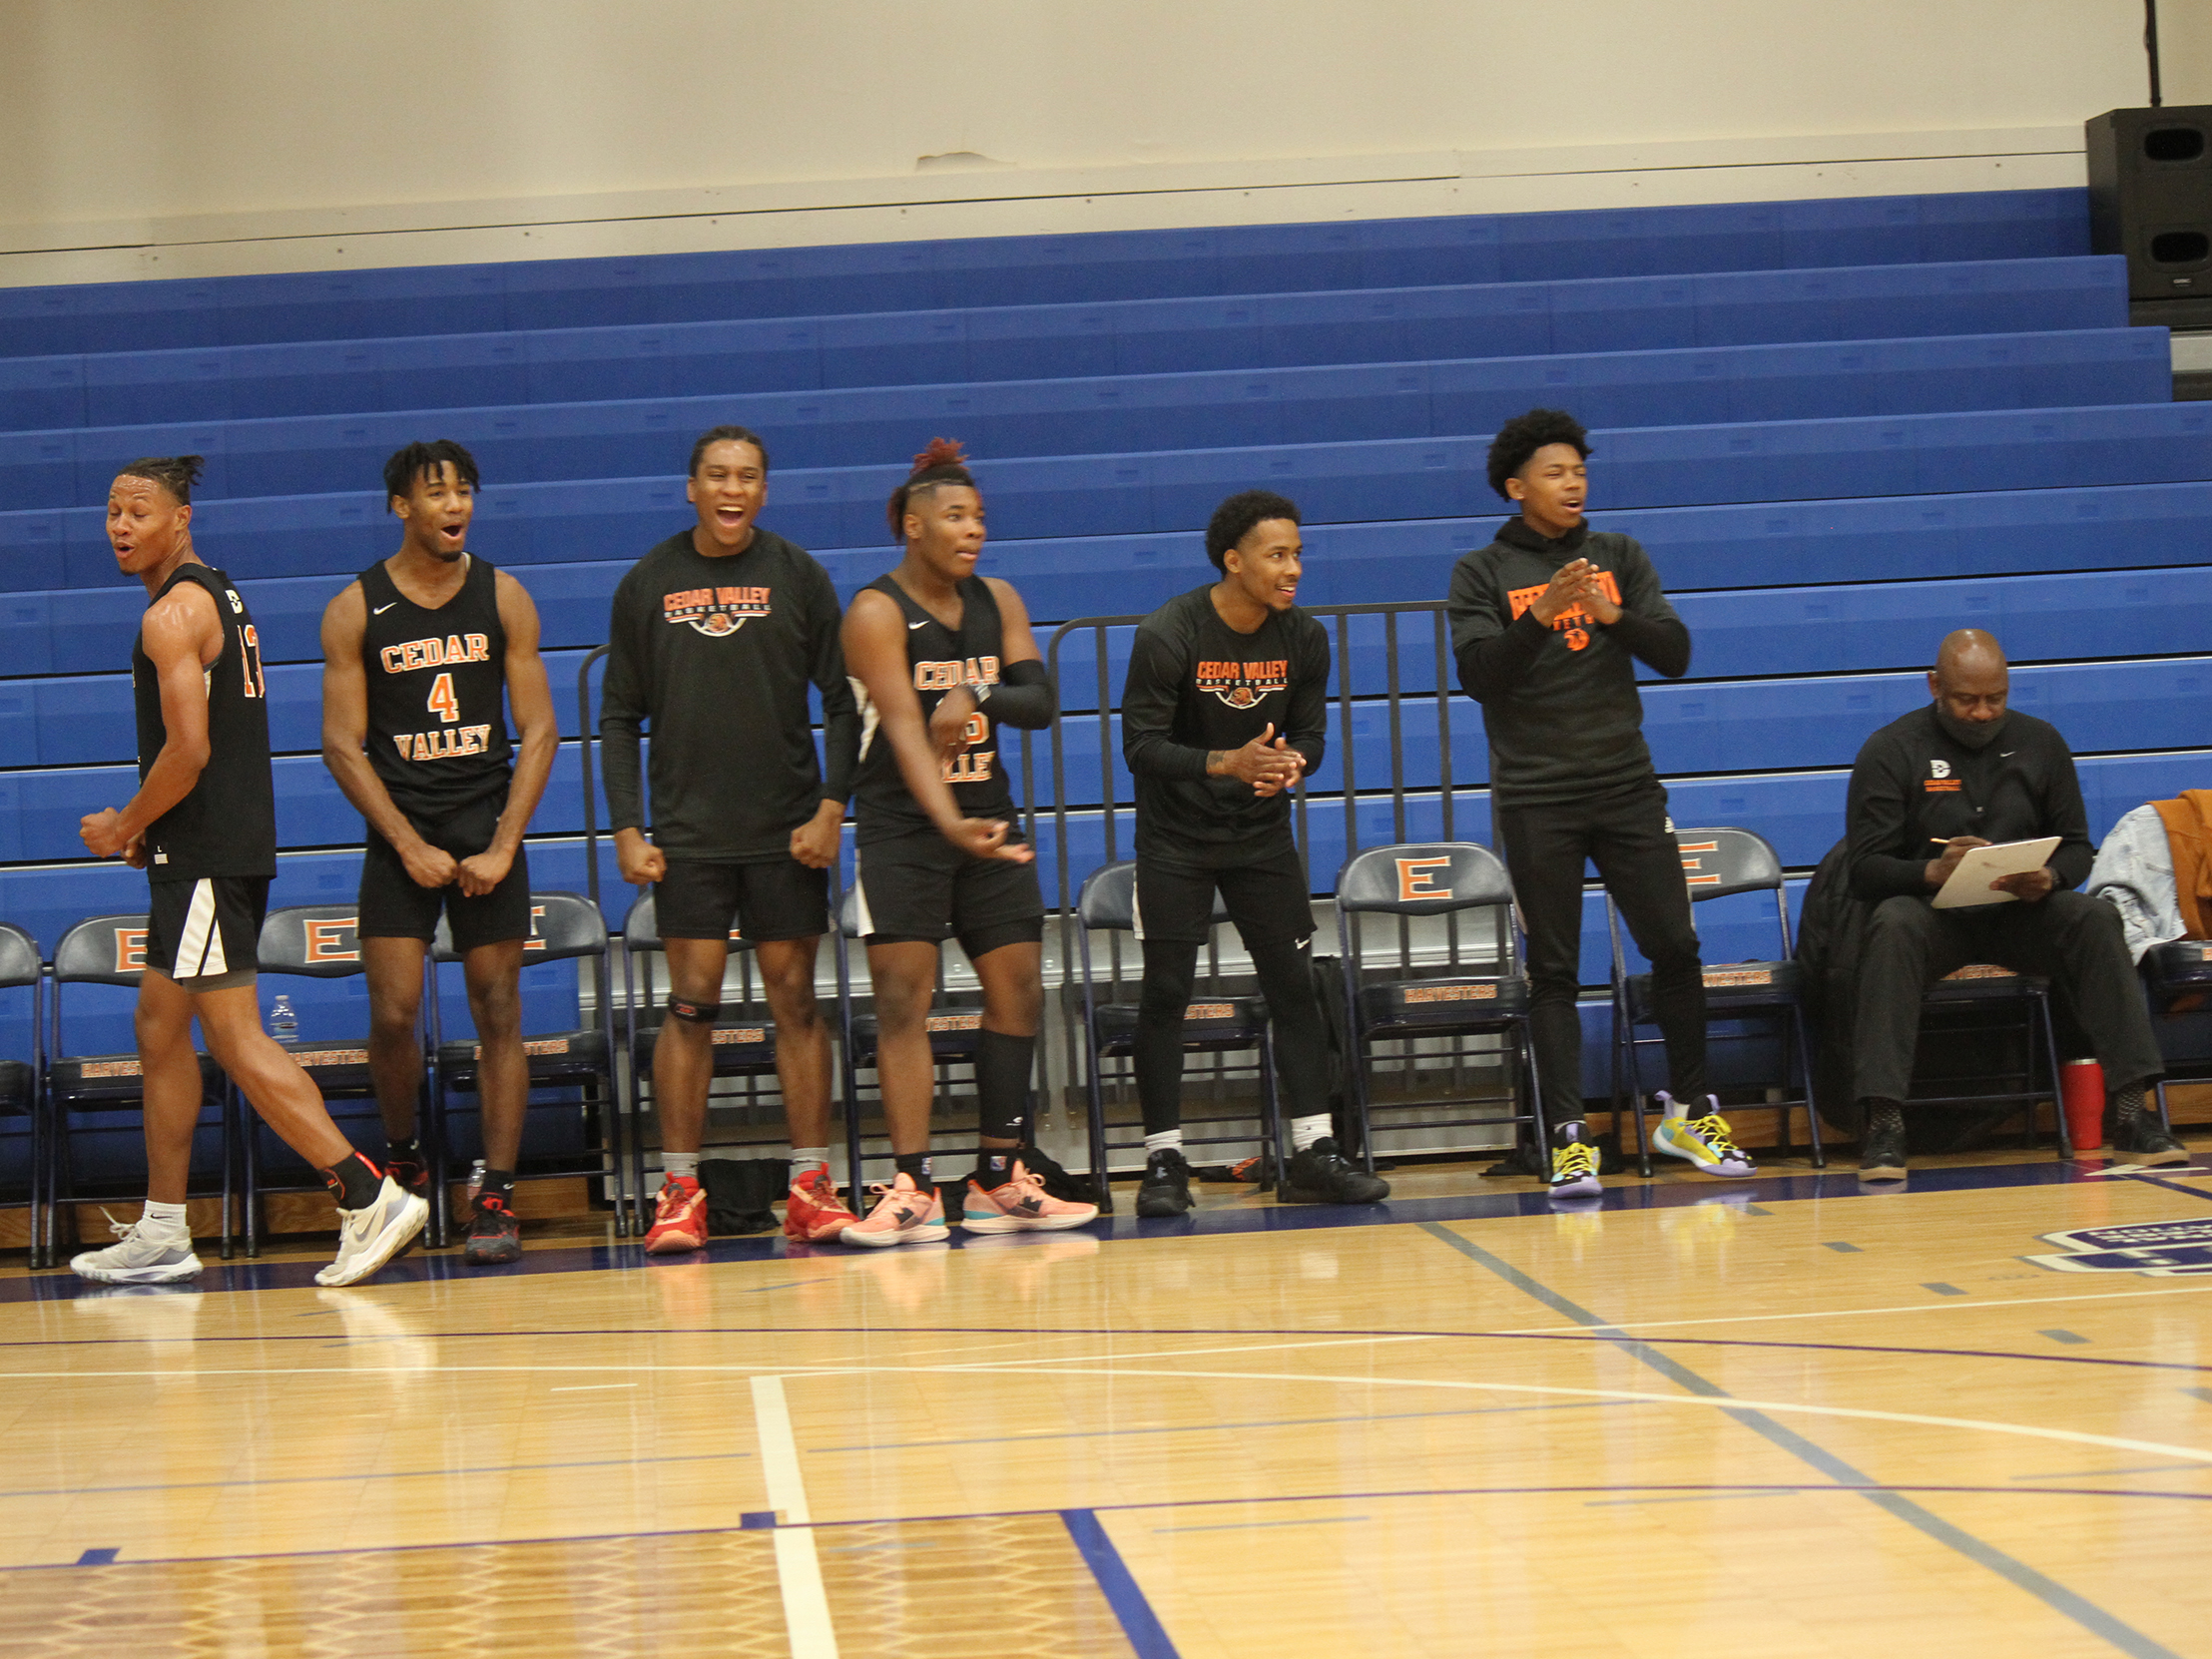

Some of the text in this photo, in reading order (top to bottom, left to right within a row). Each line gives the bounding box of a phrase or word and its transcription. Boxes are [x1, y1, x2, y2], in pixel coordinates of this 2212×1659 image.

[663, 586, 772, 612] CEDAR VALLEY
[379, 633, 490, 674] CEDAR
[1196, 660, 1288, 680] CEDAR VALLEY
[914, 655, 1000, 691] CEDAR
[427, 672, 460, 723] 4
[393, 724, 491, 762] VALLEY
[1394, 855, 1453, 902] E
[302, 916, 360, 963] E
[1403, 984, 1497, 1004] HARVESTERS
